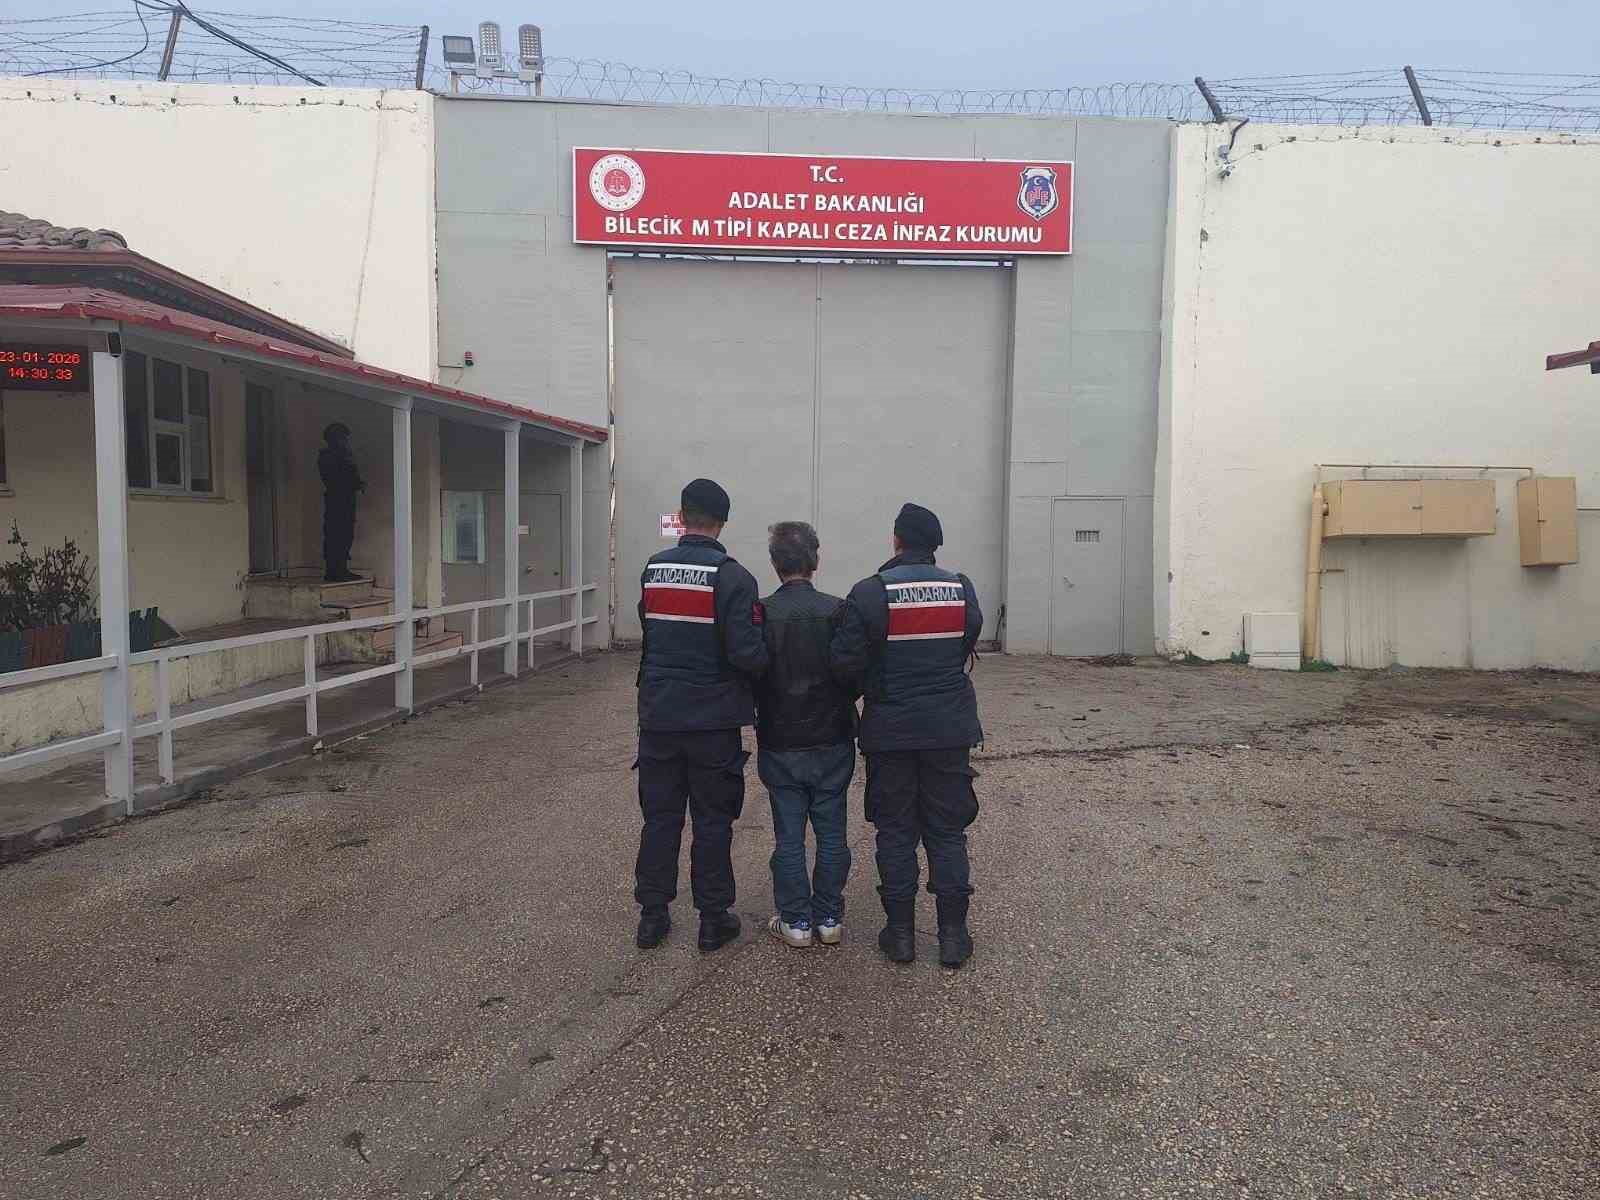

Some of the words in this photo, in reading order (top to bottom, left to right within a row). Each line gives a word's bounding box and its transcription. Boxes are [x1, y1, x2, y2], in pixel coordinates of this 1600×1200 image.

[809, 165, 844, 183] T.C.
[728, 191, 808, 211] ADALET
[815, 192, 925, 213] BAKANLIĞI
[605, 213, 683, 235] BİLECİK
[692, 220, 709, 235] M
[714, 217, 751, 238] TİPİ
[757, 221, 829, 239] KAPALI
[835, 223, 887, 240] CEZA
[893, 220, 951, 242] İNFAZ
[956, 226, 1042, 243] KURUMU
[649, 568, 708, 585] JANDARMA
[896, 587, 959, 603] JANDARMA
